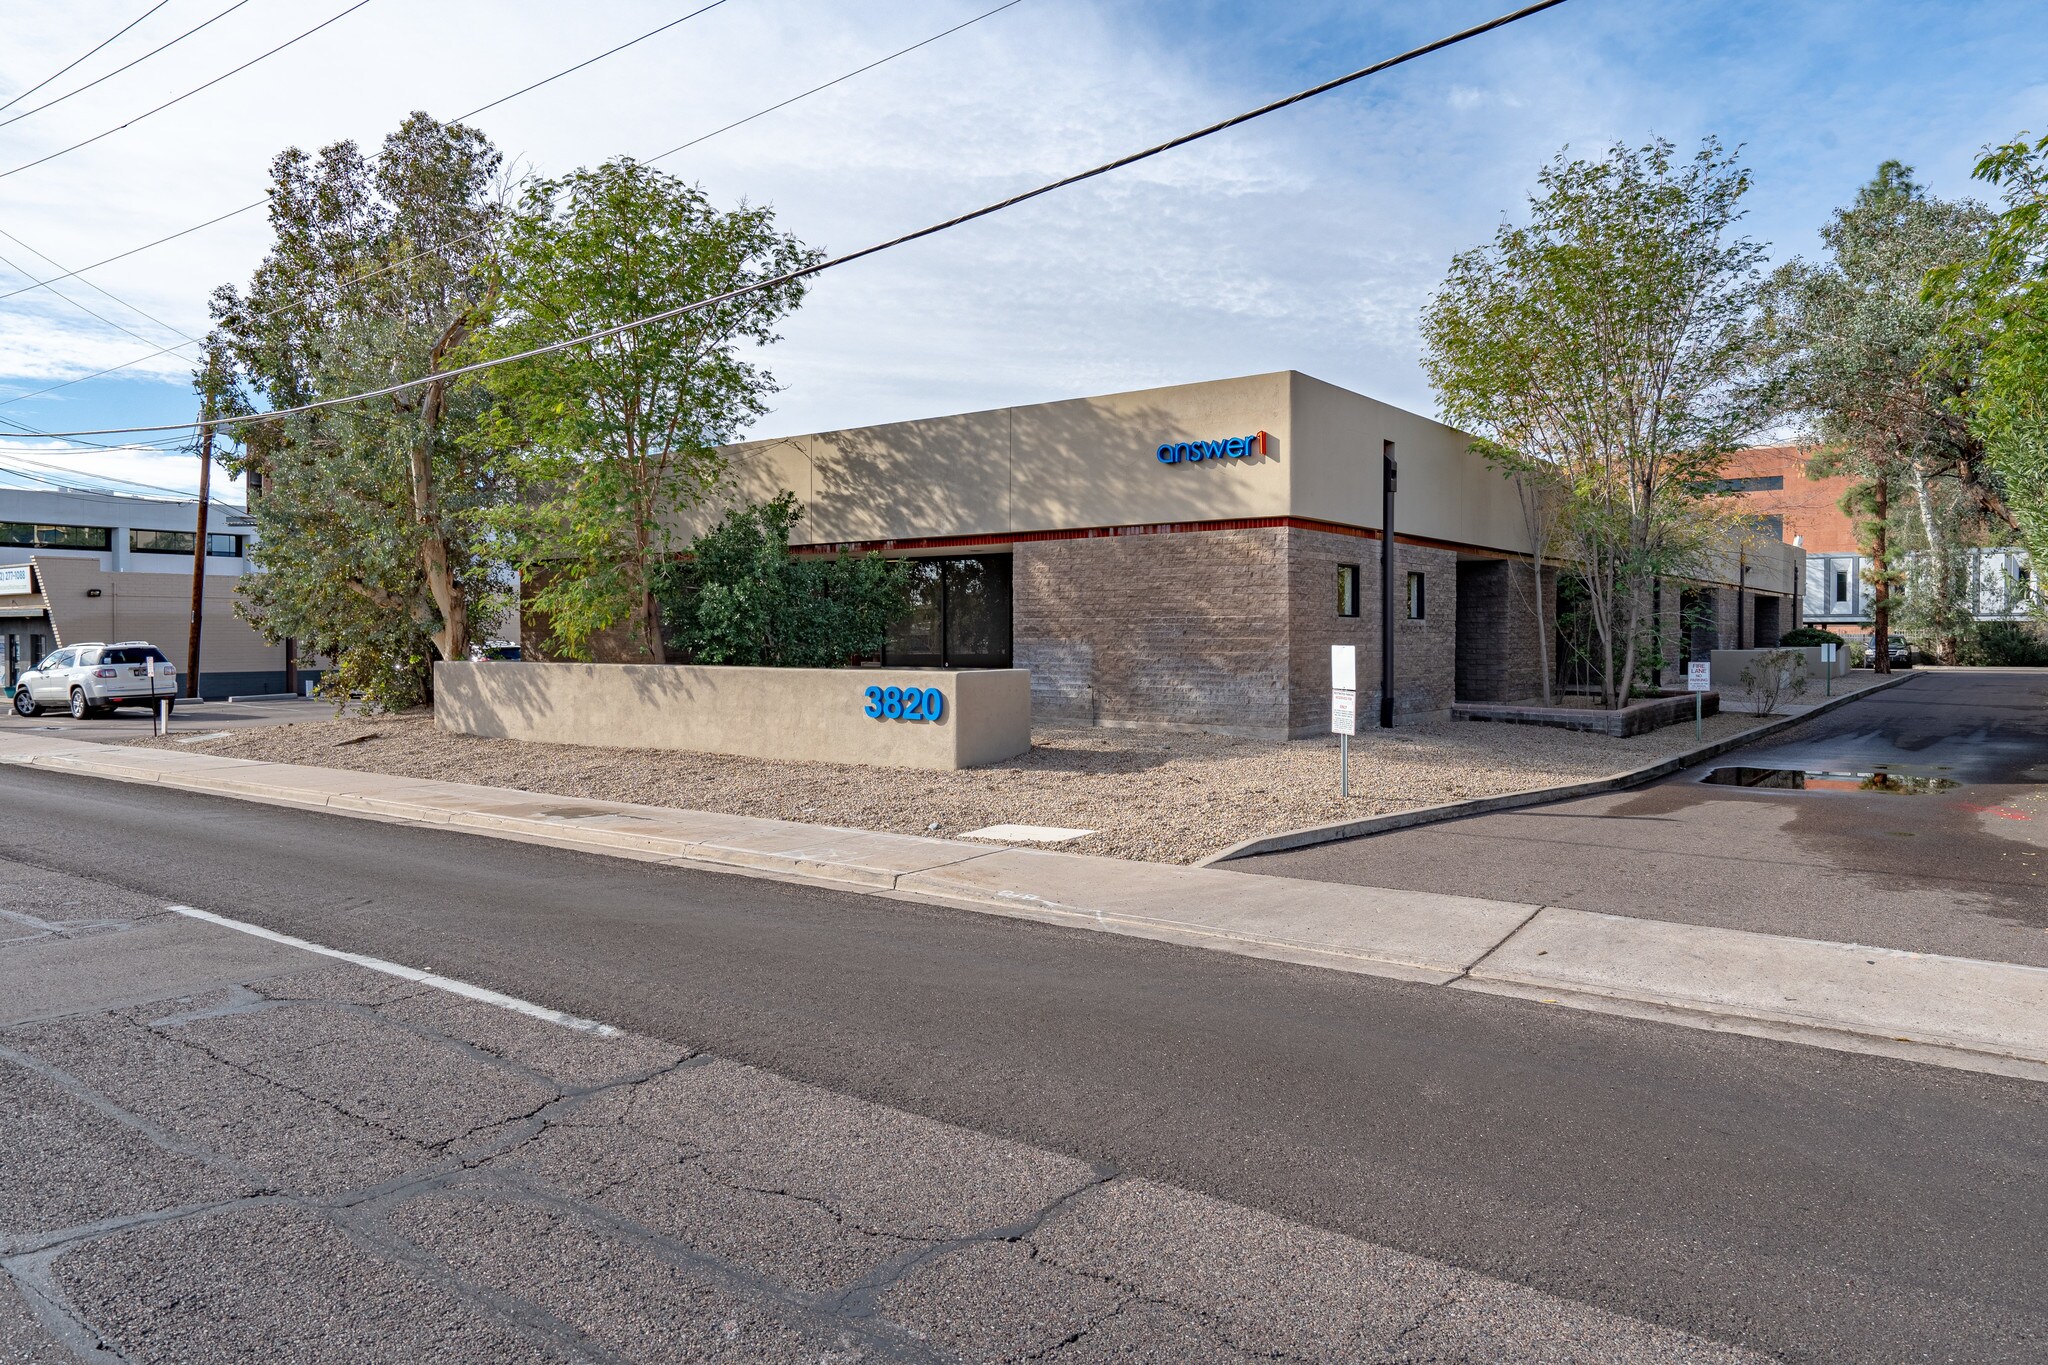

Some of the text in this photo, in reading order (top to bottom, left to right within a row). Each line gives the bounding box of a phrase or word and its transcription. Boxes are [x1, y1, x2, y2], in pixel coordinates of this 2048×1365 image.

[1157, 430, 1266, 463] answer1
[5, 570, 26, 581] 277-1088
[864, 685, 944, 722] 3820
